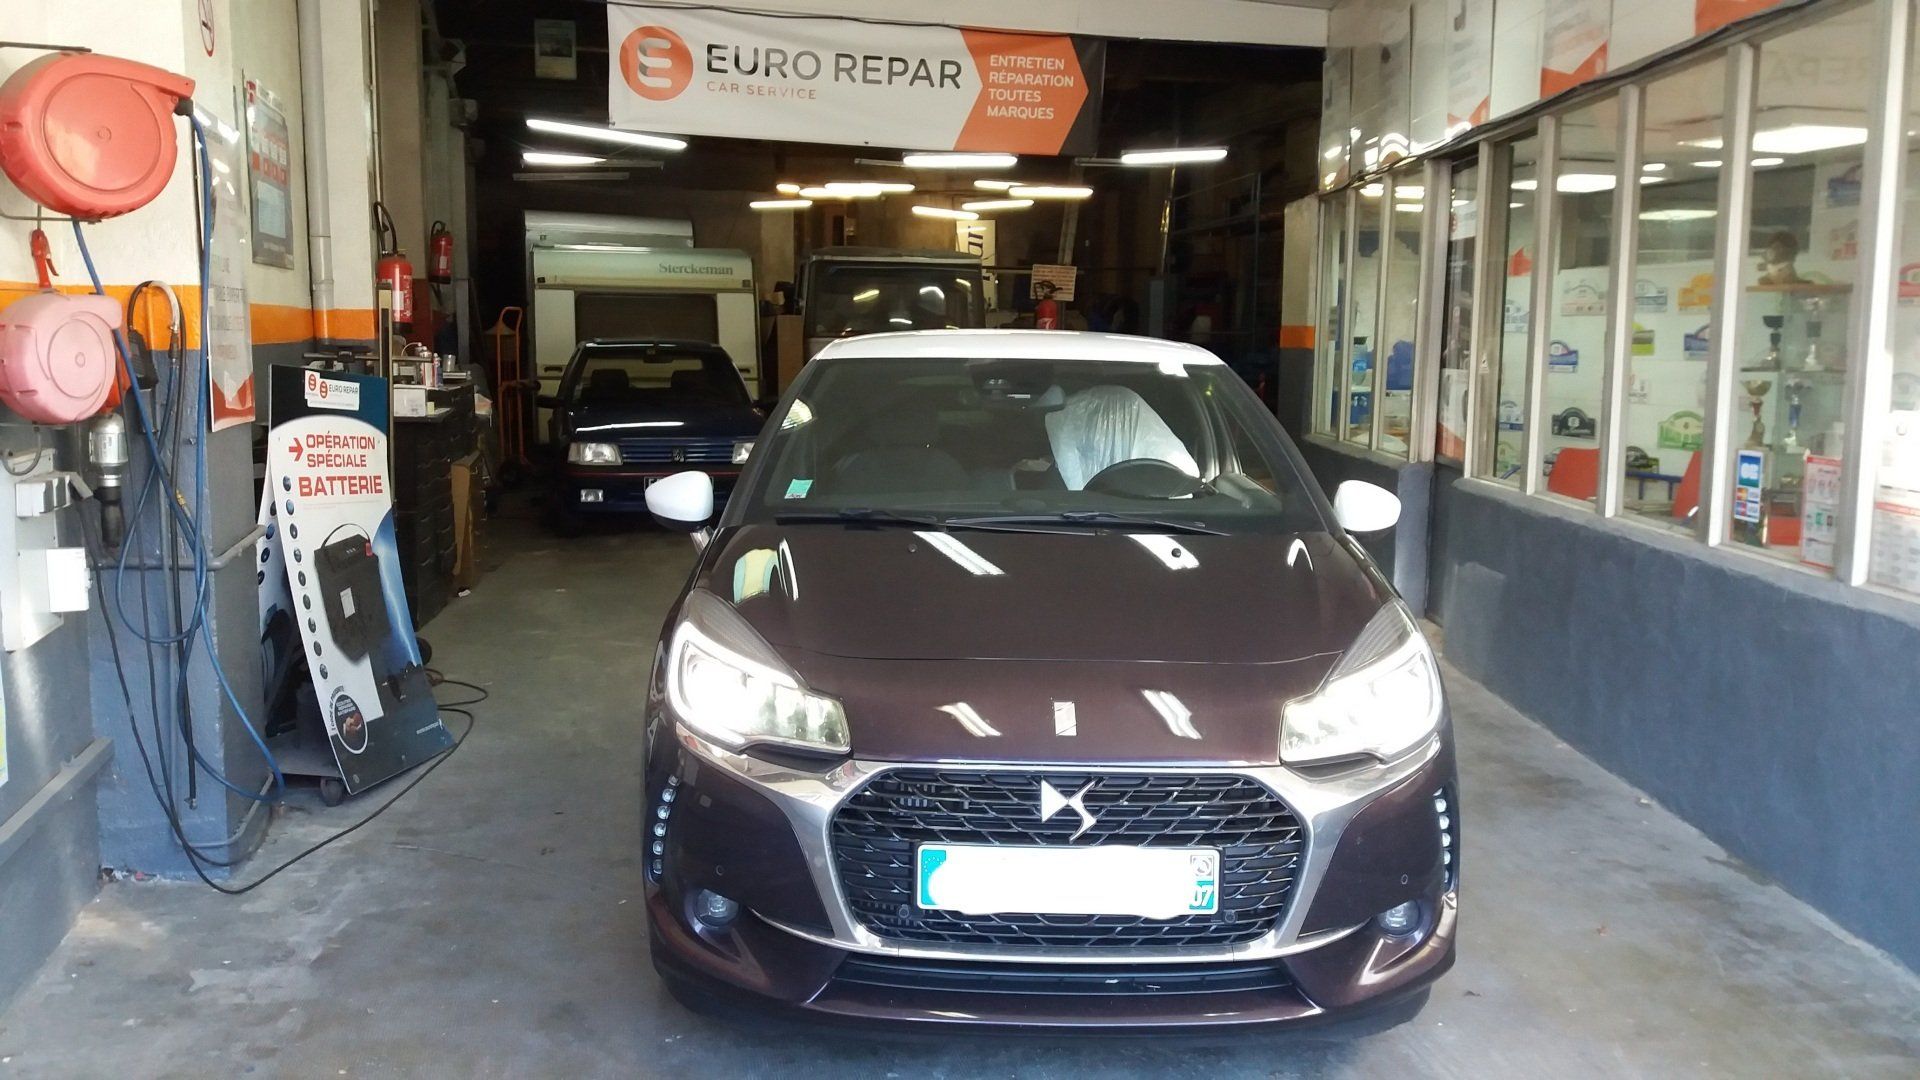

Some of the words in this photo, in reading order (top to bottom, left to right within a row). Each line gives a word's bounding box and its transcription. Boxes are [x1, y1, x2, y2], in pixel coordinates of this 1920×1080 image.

[706, 43, 822, 81] EURO
[834, 52, 962, 90] REPAR
[990, 54, 1064, 70] ENTRETIEN
[989, 69, 1074, 87] RÉPARATION
[707, 80, 740, 94] CAR
[746, 84, 817, 100] SERVICE
[988, 88, 1042, 102] TOUTES
[987, 105, 1054, 120] MARQUES
[657, 263, 733, 276] Sterckeman
[328, 383, 342, 393] EURO
[343, 385, 359, 394] REPAR
[305, 430, 375, 450] OPÉRATION
[306, 449, 367, 468] SPÉCIALE
[298, 475, 384, 497] BATTERIE
